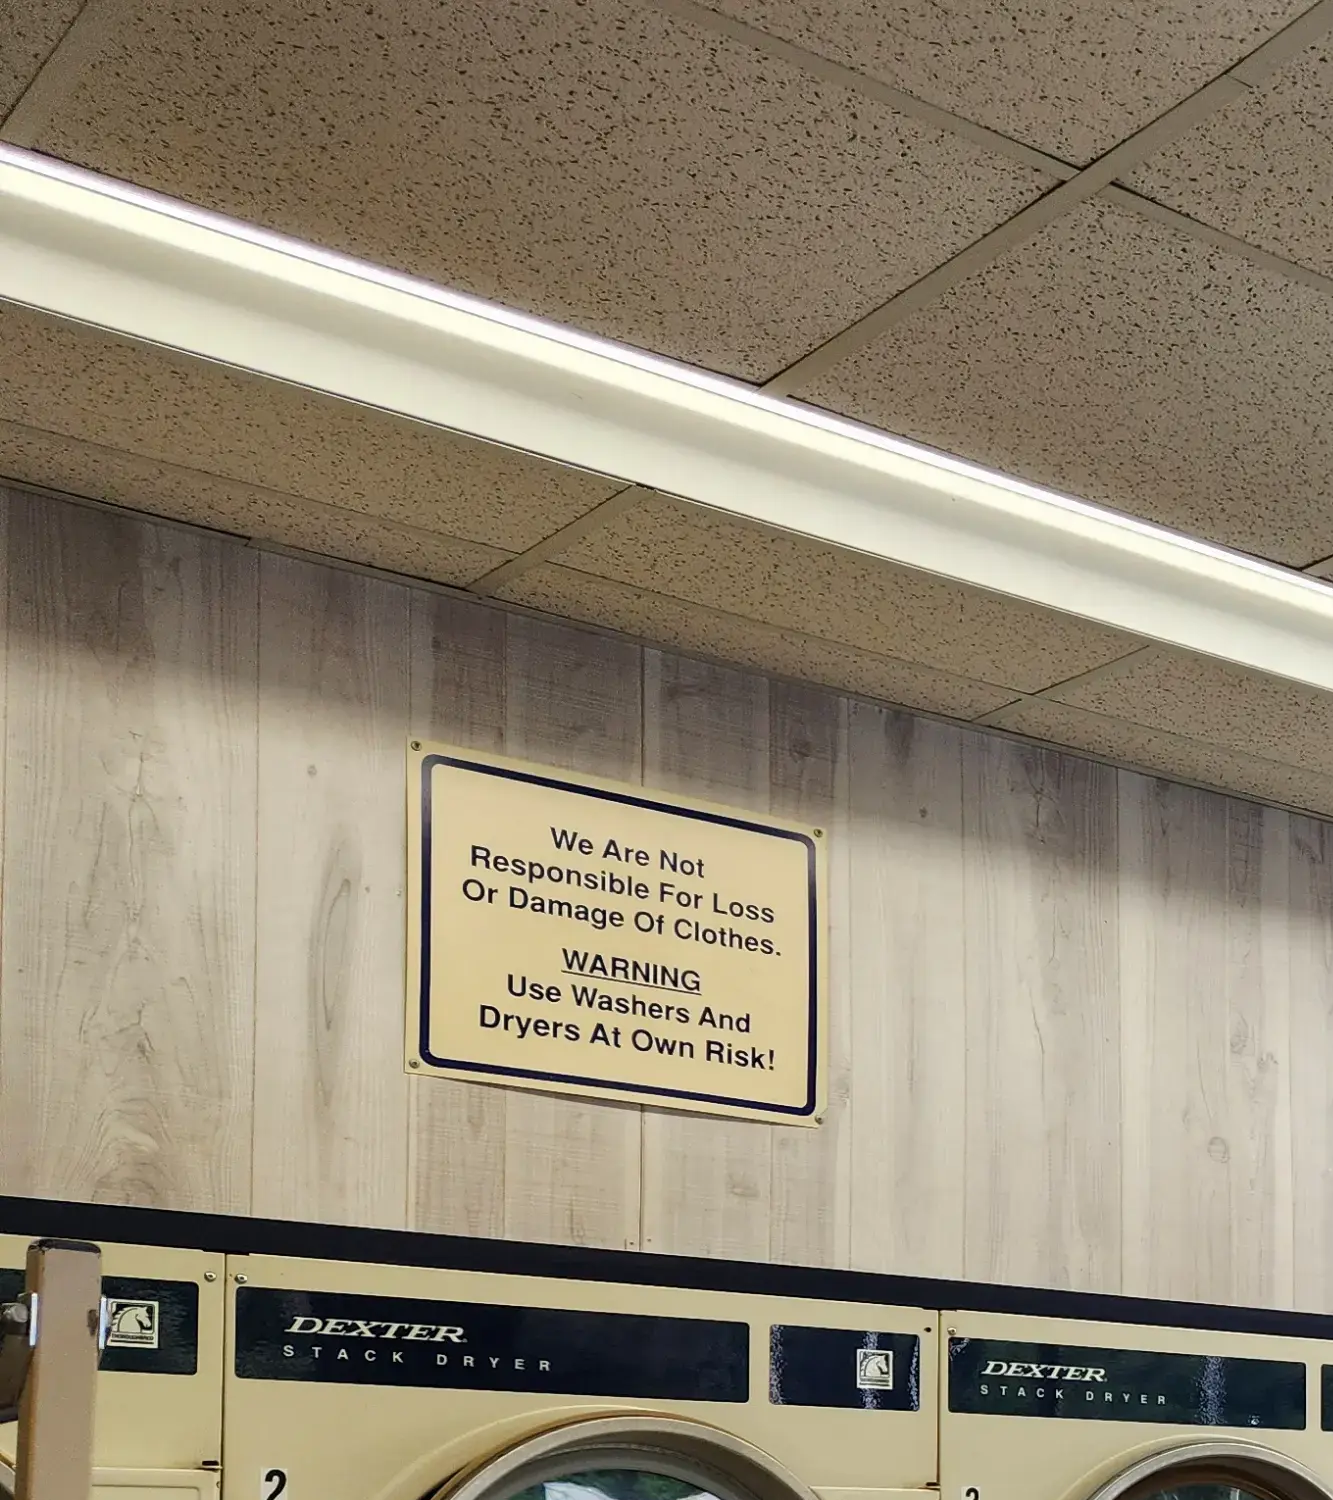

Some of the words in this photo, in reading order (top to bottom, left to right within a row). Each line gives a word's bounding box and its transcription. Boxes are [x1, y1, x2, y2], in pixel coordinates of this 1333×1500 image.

[550, 827, 594, 855] We
[602, 839, 649, 866] Are
[660, 850, 704, 878] Not
[471, 846, 649, 899] Responsible
[660, 882, 703, 909] For
[713, 893, 775, 923] Loss
[461, 878, 498, 904] Or
[509, 887, 625, 930] Damage
[634, 912, 665, 935] Of
[674, 919, 782, 957] Clothes.
[562, 948, 702, 993] WARNING
[507, 973, 562, 1003] Use
[571, 984, 690, 1025] Washers
[699, 1009, 751, 1034] And
[479, 1004, 580, 1042] Dryers
[589, 1024, 621, 1048] At
[631, 1030, 694, 1059] Own
[705, 1041, 775, 1072] Risk!
[284, 1316, 465, 1343] DEXTER
[283, 1345, 403, 1363] STACK
[436, 1354, 551, 1371] DRYER
[981, 1360, 1105, 1382] DEXTER
[980, 1385, 1064, 1400] STACK
[1086, 1391, 1166, 1405] DRYER
